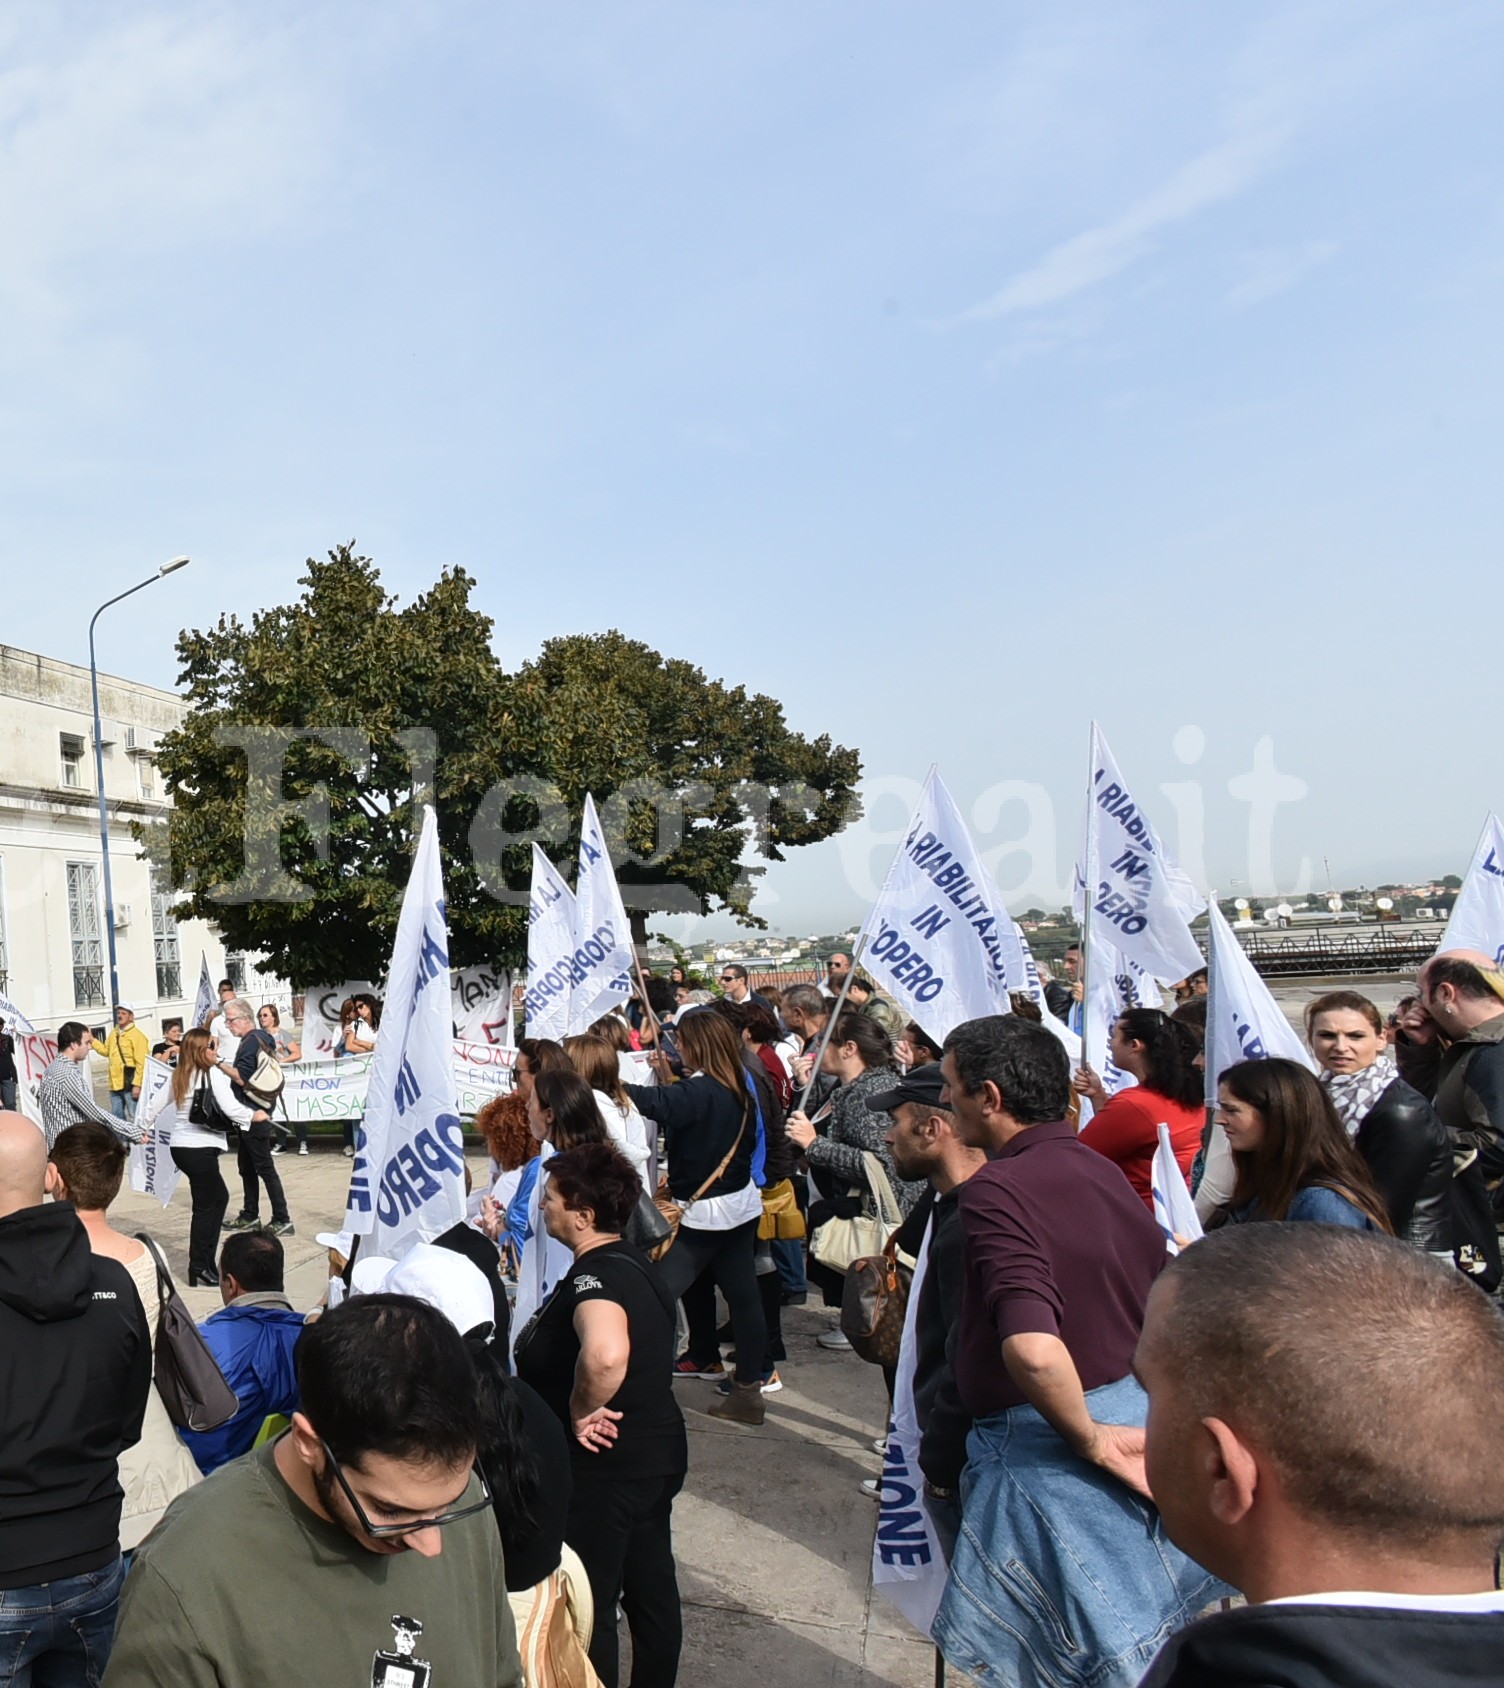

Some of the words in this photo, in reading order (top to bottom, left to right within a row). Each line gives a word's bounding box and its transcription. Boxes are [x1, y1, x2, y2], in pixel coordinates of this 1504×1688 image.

[1110, 850, 1149, 881] IN
[910, 904, 951, 940] IN
[870, 918, 944, 1003] OPERO
[300, 1077, 341, 1091] NON
